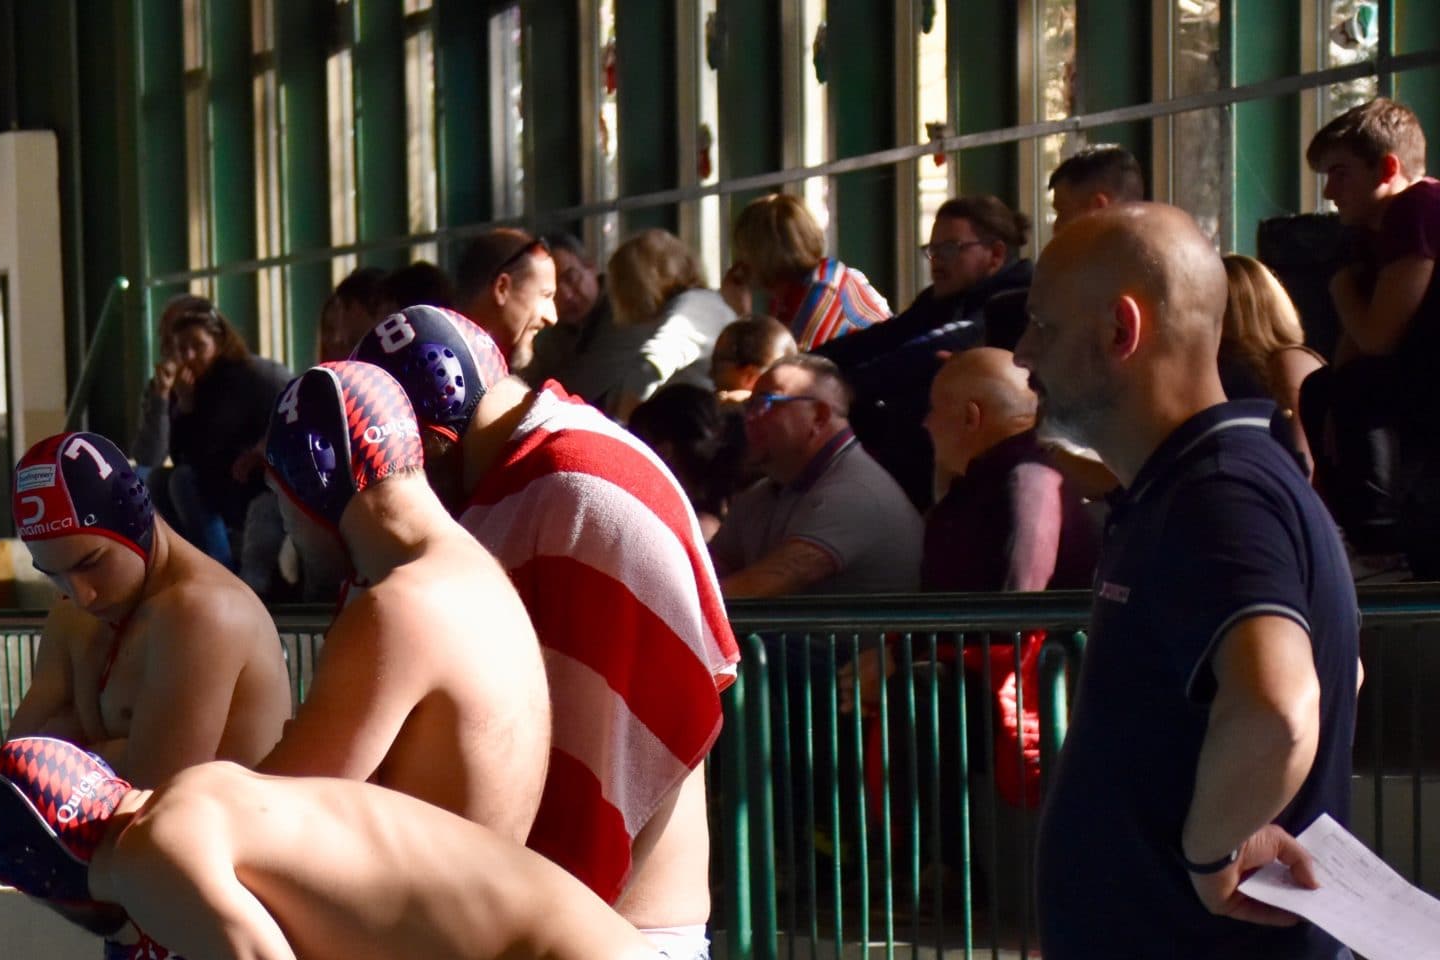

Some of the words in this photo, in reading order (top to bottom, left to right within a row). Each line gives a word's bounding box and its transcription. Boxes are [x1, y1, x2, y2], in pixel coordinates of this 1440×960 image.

[374, 312, 416, 354] 8
[277, 374, 304, 425] 4
[63, 437, 114, 481] 7
